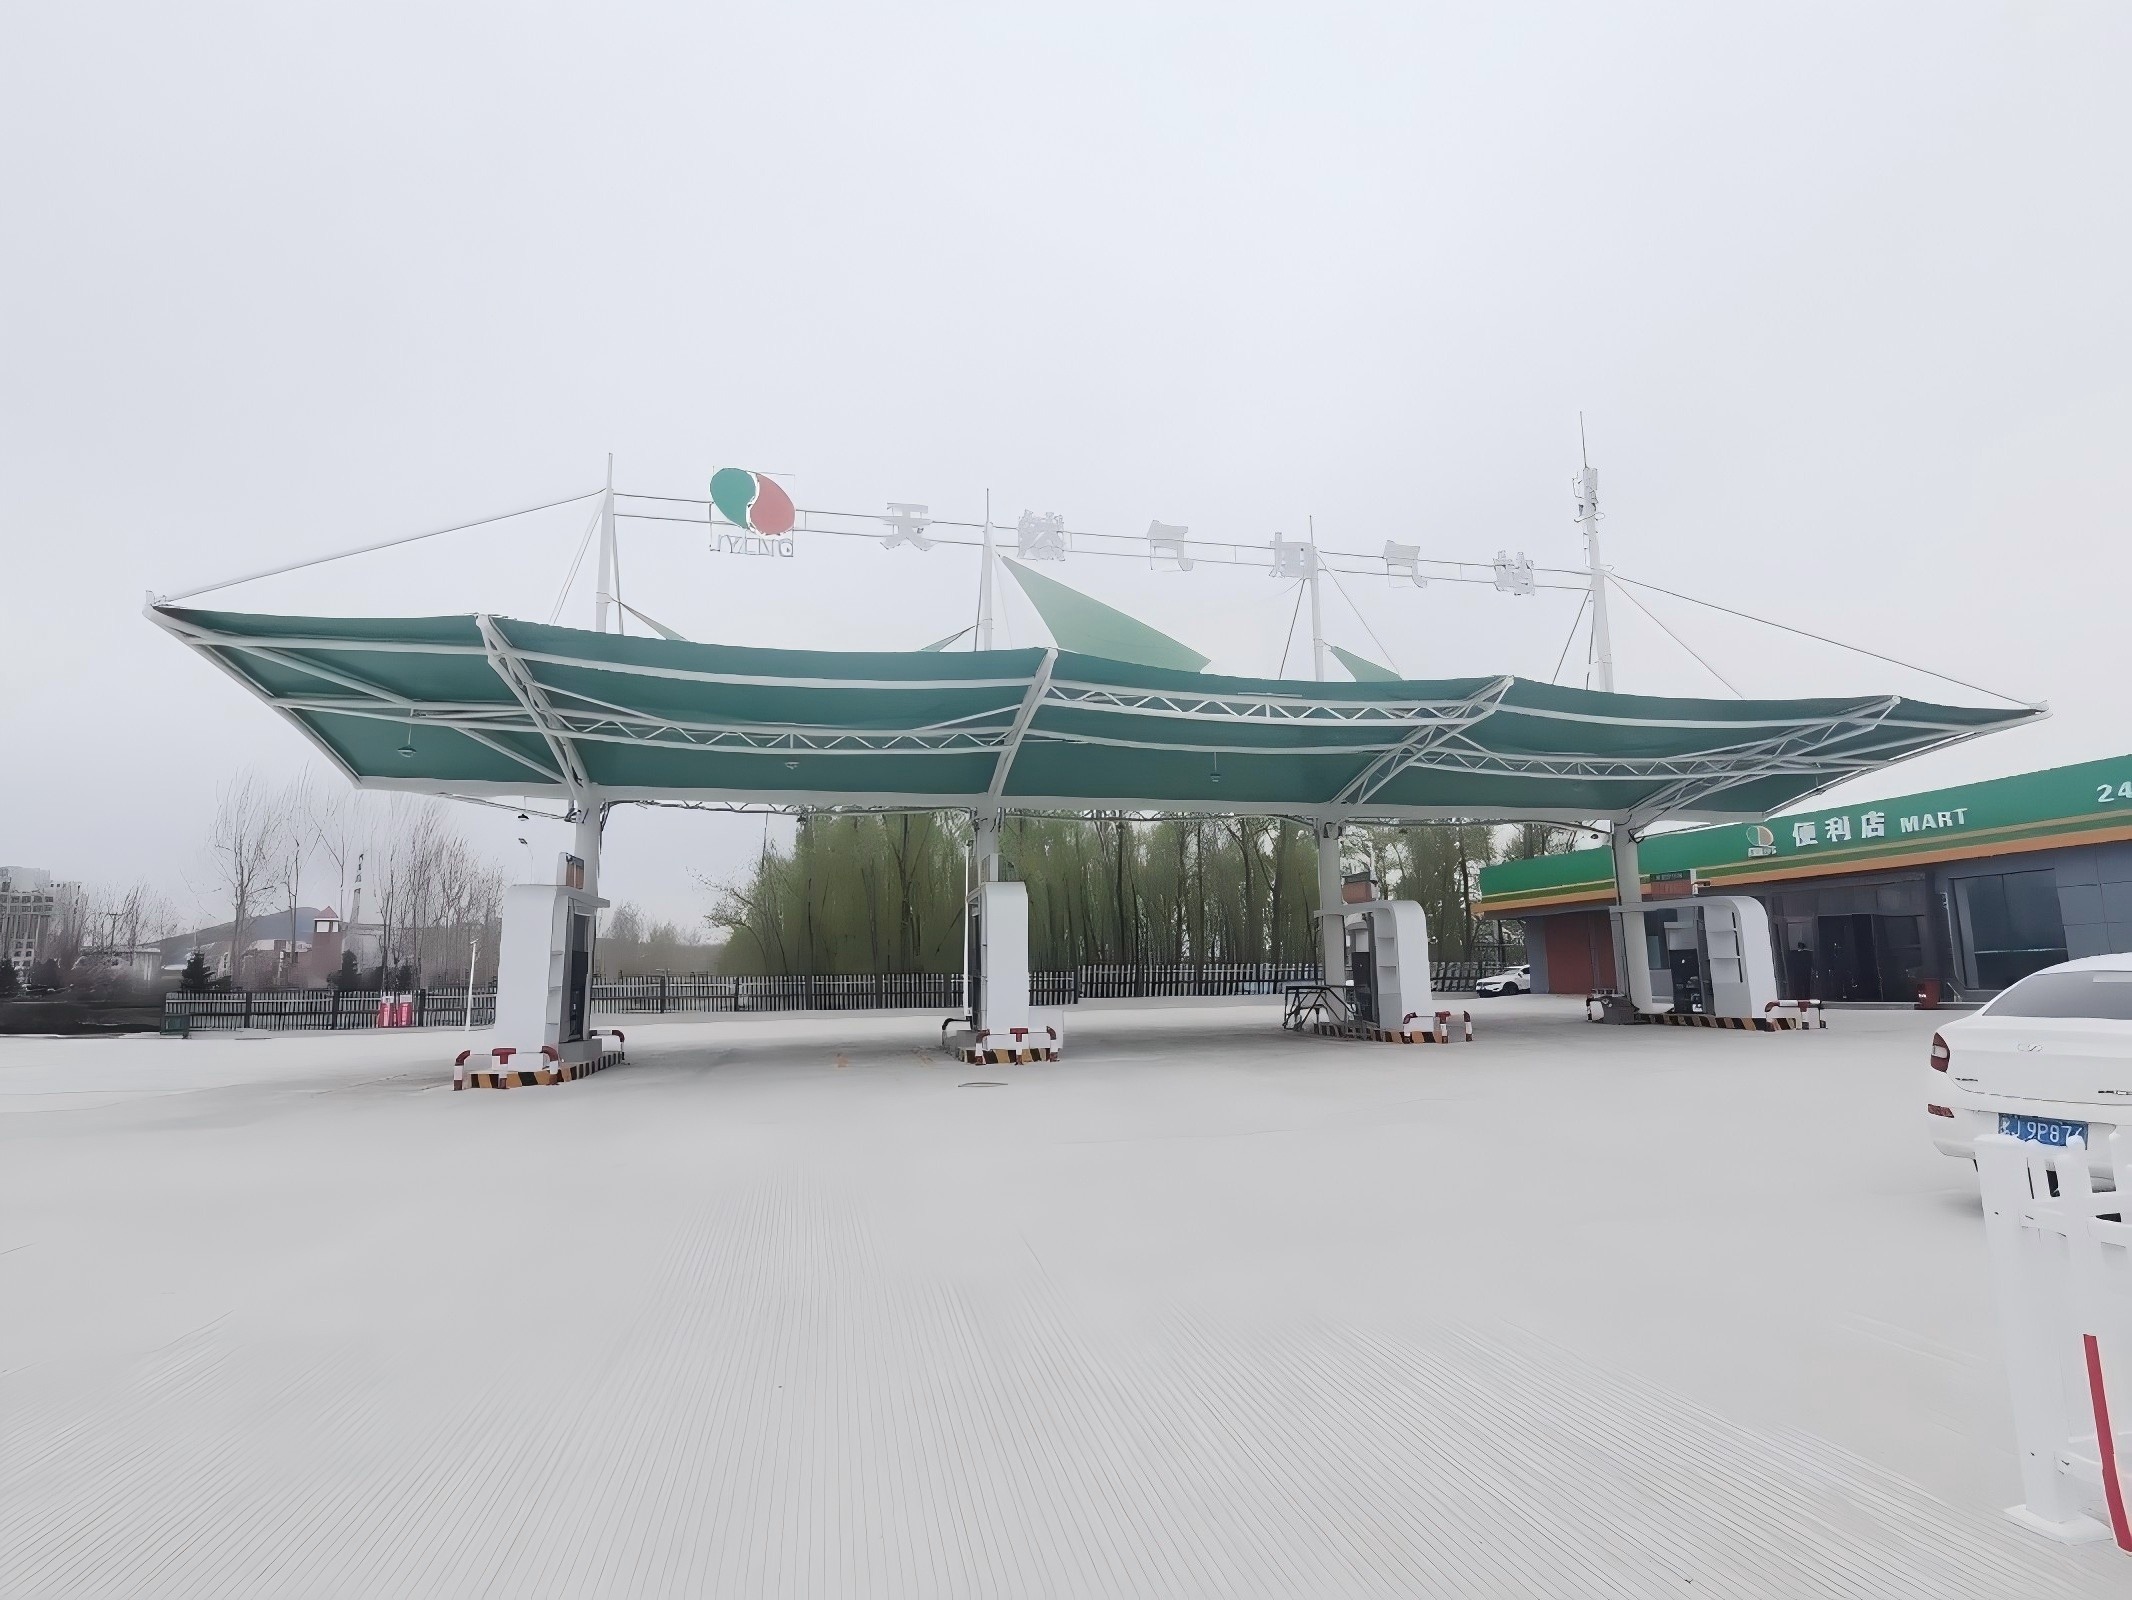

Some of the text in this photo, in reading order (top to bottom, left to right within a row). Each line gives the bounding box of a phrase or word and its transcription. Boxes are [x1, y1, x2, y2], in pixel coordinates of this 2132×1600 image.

[1792, 807, 1968, 848] 便利店 MART
